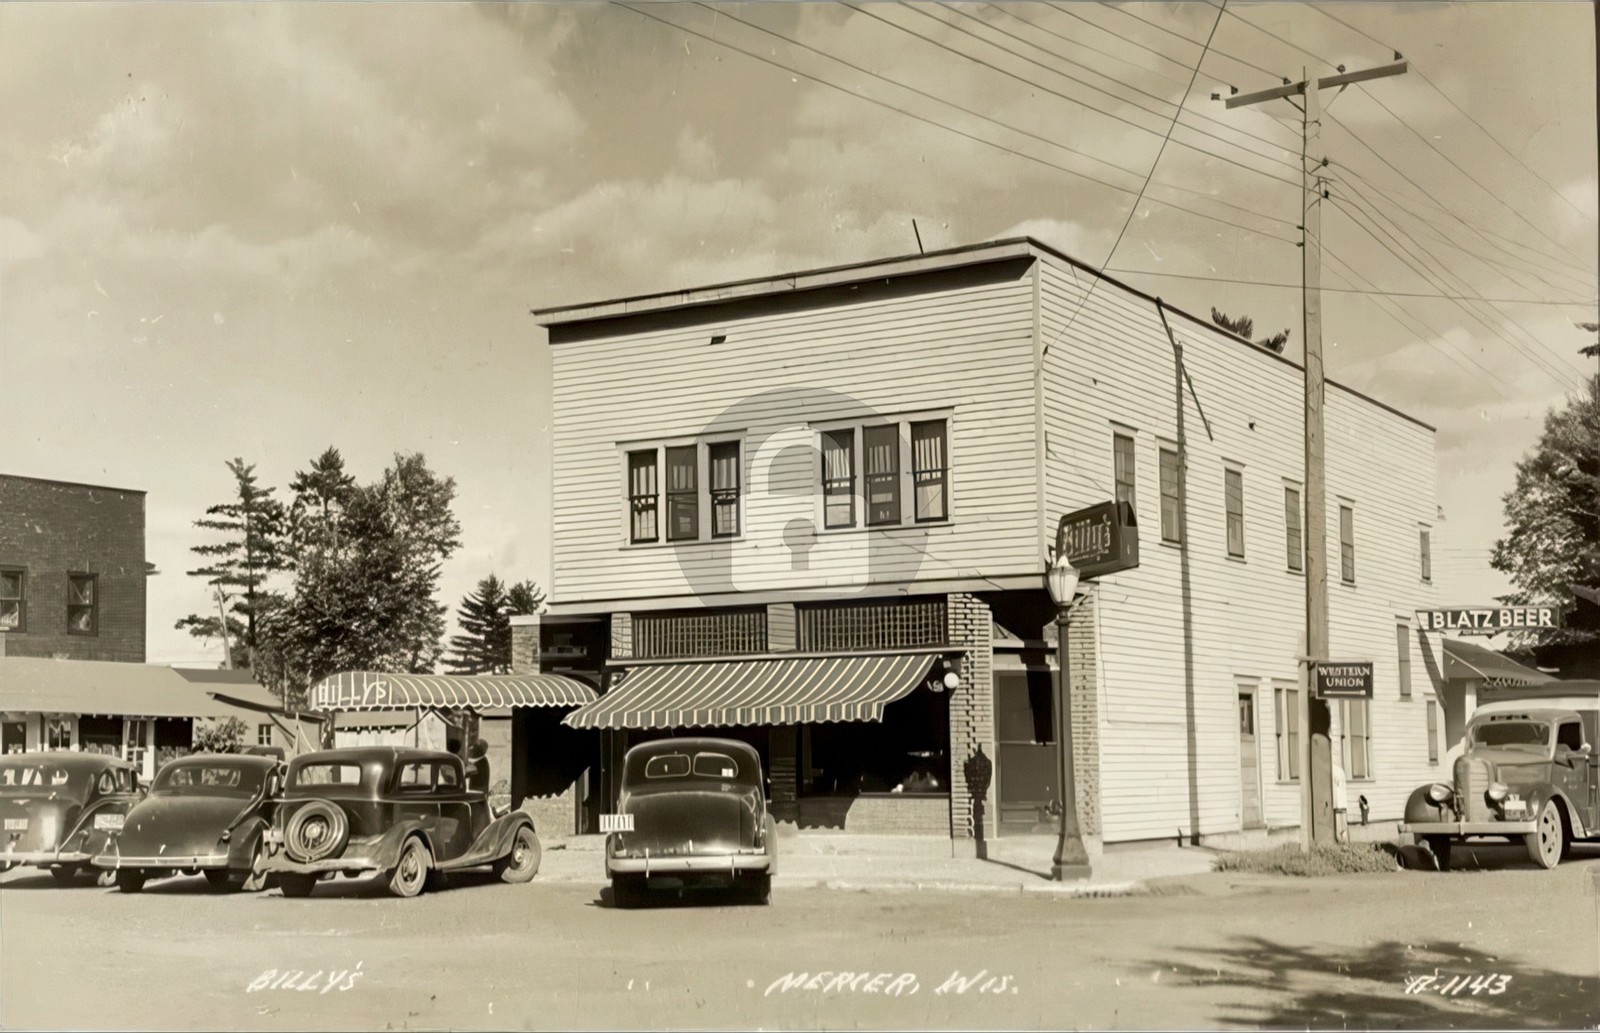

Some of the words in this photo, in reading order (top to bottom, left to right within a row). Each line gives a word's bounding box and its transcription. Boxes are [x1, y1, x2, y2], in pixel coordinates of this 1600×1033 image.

[1432, 610, 1494, 629] BLATZ
[1499, 608, 1553, 628] BEER
[1326, 677, 1364, 688] UNION
